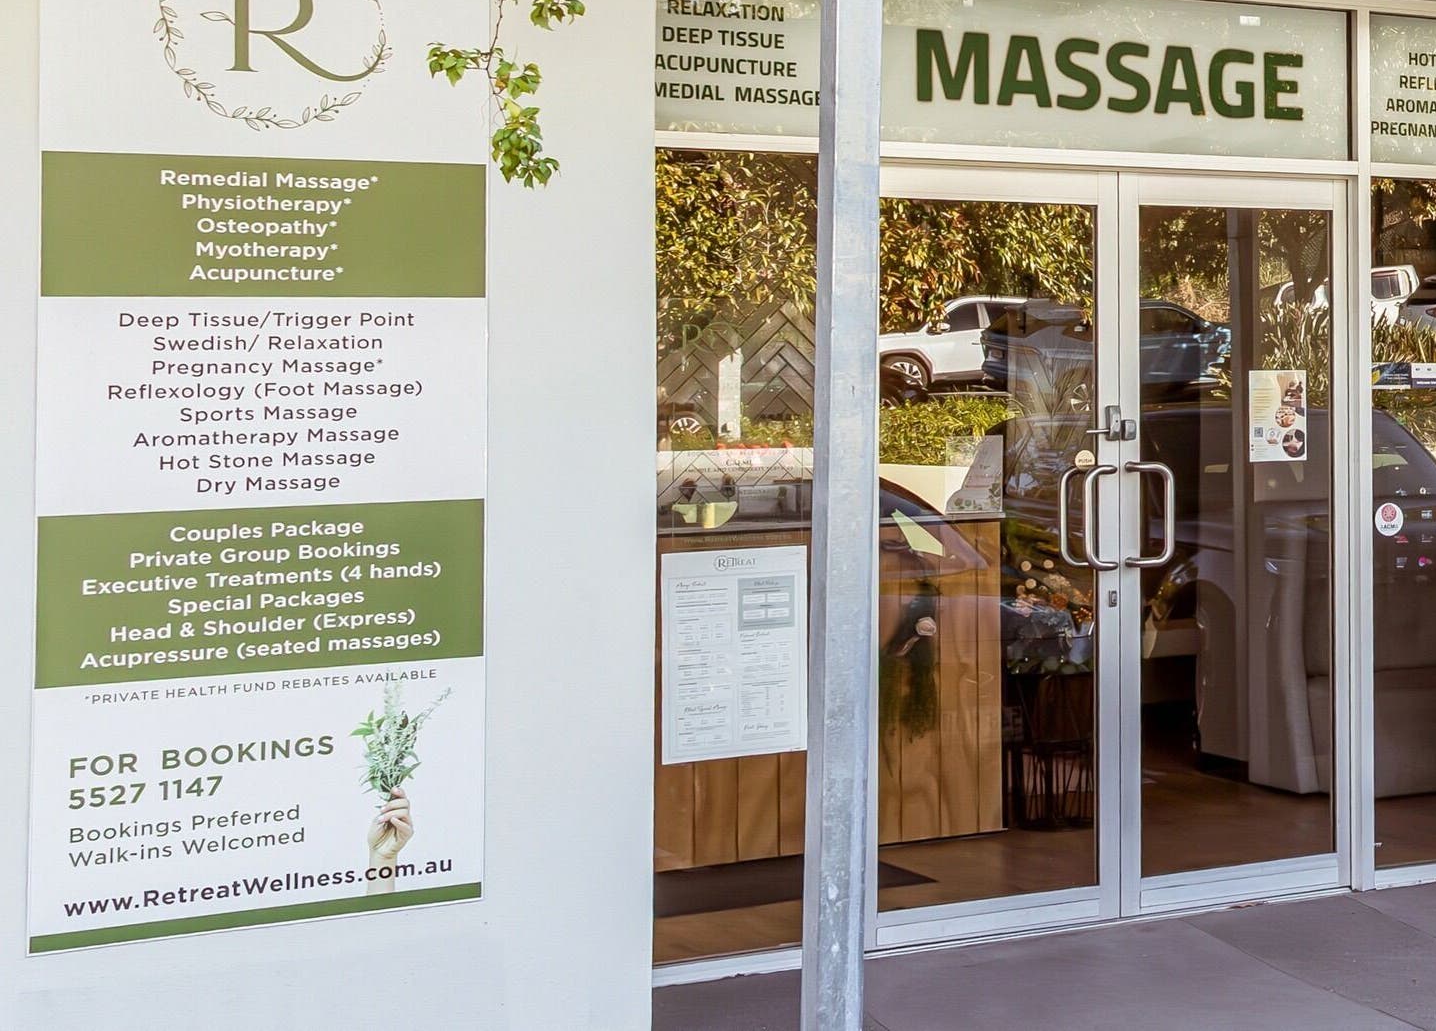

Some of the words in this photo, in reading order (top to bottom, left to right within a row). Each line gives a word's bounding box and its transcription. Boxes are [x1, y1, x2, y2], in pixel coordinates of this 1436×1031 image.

[668, 0, 784, 21] RELAXATION
[663, 26, 712, 44] DEEP
[718, 30, 784, 49] TISSUE
[656, 54, 797, 77] ACUPUNCTURE
[1409, 52, 1436, 66] HOT
[915, 29, 1304, 121] MASSAGE
[655, 82, 724, 100] MEDIAL
[736, 87, 820, 105] MASSAGE
[161, 170, 267, 187] Remedial
[120, 313, 179, 330] Deep
[189, 311, 351, 329] Tissue/Trigger
[361, 312, 414, 326] Point
[153, 334, 259, 352] Swedish/
[269, 335, 382, 350] Relaxation
[153, 361, 272, 377] Pregnancy
[109, 383, 244, 400] Reflexology
[255, 383, 314, 399] (Foot
[324, 381, 422, 397] Massage)
[181, 408, 254, 425] Sports
[265, 406, 357, 421] Massage
[133, 431, 298, 447] Aromatherapy
[308, 428, 399, 443] Massage
[160, 456, 199, 470] Hot
[209, 455, 272, 468] Stone
[283, 452, 375, 467] Massage
[197, 479, 236, 494] Dry
[246, 477, 340, 491] Massage
[170, 524, 262, 542] Couples
[271, 520, 363, 542] Package
[131, 551, 212, 568] Private
[220, 546, 290, 568] Group
[299, 542, 400, 559] Bookings
[83, 575, 197, 595] Executive
[206, 568, 332, 588] Treatments
[341, 565, 362, 582] (4
[370, 562, 441, 578] hands)
[168, 594, 251, 616] Special
[261, 591, 364, 608] Packages
[111, 623, 171, 642] Head
[180, 622, 194, 637] &
[204, 616, 306, 635] Shoulder
[314, 609, 415, 630] (Express)
[80, 647, 228, 668] Acupressure
[237, 637, 320, 659] (seated
[329, 630, 440, 651] massages)
[166, 685, 227, 698] HEALTH
[234, 682, 275, 693] FUND
[282, 676, 349, 689] REBATES
[355, 669, 437, 684] AVAILABLE
[70, 754, 137, 778] FOR
[162, 736, 333, 769] BOOKINGS
[69, 783, 145, 809] 5527
[159, 776, 222, 800] 1147
[70, 821, 181, 843] Bookings
[192, 805, 299, 830] Preferred
[69, 844, 172, 867] Walk-ins
[182, 827, 304, 854] Welcomed
[64, 859, 453, 917] www.RetreatWellness.com.au
